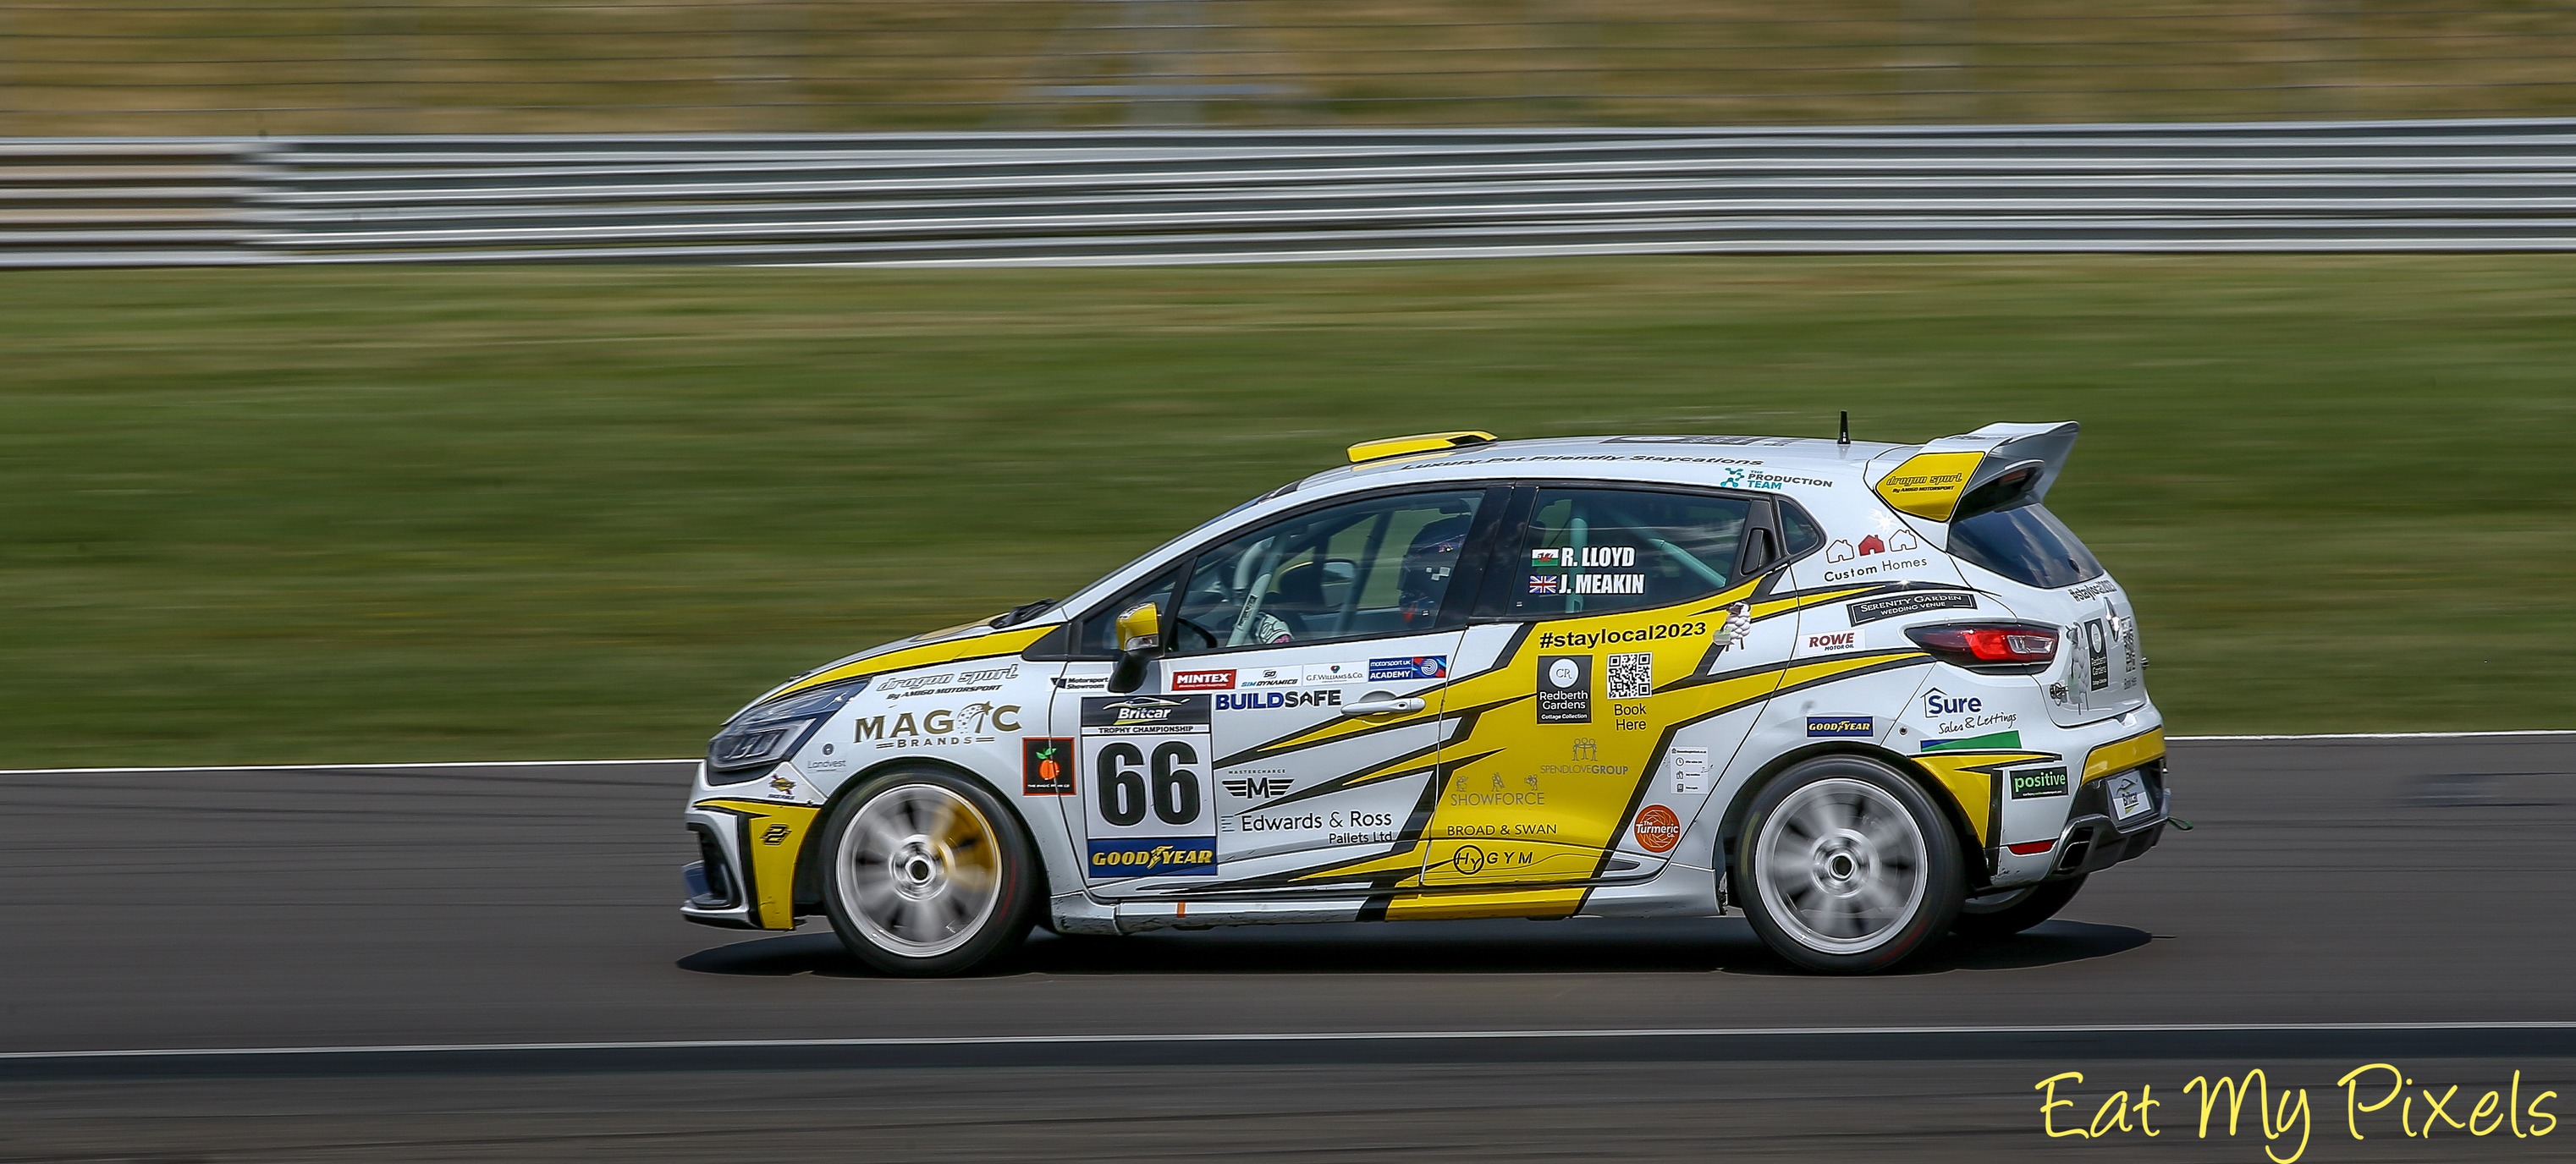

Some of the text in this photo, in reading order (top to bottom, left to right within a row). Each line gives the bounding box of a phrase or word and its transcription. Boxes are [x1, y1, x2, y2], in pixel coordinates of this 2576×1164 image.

[1401, 459, 1482, 469] Luxury
[1629, 455, 1764, 465] Staycations
[1748, 473, 1833, 488] PRODUCTION
[1748, 480, 1782, 490] TEAM
[1886, 473, 1962, 486] dragon sport
[1560, 547, 1635, 567] R. LLOYD
[1825, 557, 1928, 582] Custom Homes
[1559, 574, 1644, 594] J. MEAKIN
[1860, 595, 1962, 612] SERENITY GARDEN
[1880, 604, 1919, 615] WEDDING
[1539, 622, 1706, 649] #staylocal2023
[1808, 632, 1855, 648] ROWE
[876, 663, 1019, 692] dragon sport
[1177, 673, 1230, 684] MINTEX
[1370, 671, 1411, 679] ACADEMY
[1555, 668, 1572, 679] CR
[935, 684, 1003, 695] MOTORSPORT
[1539, 690, 1588, 700] Redberth
[1215, 689, 1342, 710] BUILDSAFE
[1542, 700, 1586, 710] Gardens
[1928, 695, 1983, 714] Sure
[1117, 707, 1172, 719] Britcar
[1614, 703, 1647, 716] Book
[1616, 719, 1646, 731] Here
[1808, 720, 1871, 733] GOODYEAR
[1938, 712, 2017, 734] Sales & Lettings
[897, 737, 972, 748] BRANDS
[1540, 765, 1629, 775] SPENDLOVEGROUP
[1098, 741, 1203, 826] 66
[2014, 771, 2066, 793] positive
[1450, 792, 1544, 806] SHOWFORCE
[1241, 810, 1392, 832] Edwards & Ross
[1447, 824, 1556, 836] BROAD & SWAN
[1636, 823, 1679, 833] Turmeric
[1329, 832, 1392, 844] Pallets Ltd
[1092, 845, 1214, 870] GOODYEAR
[1487, 852, 1533, 864] GYM
